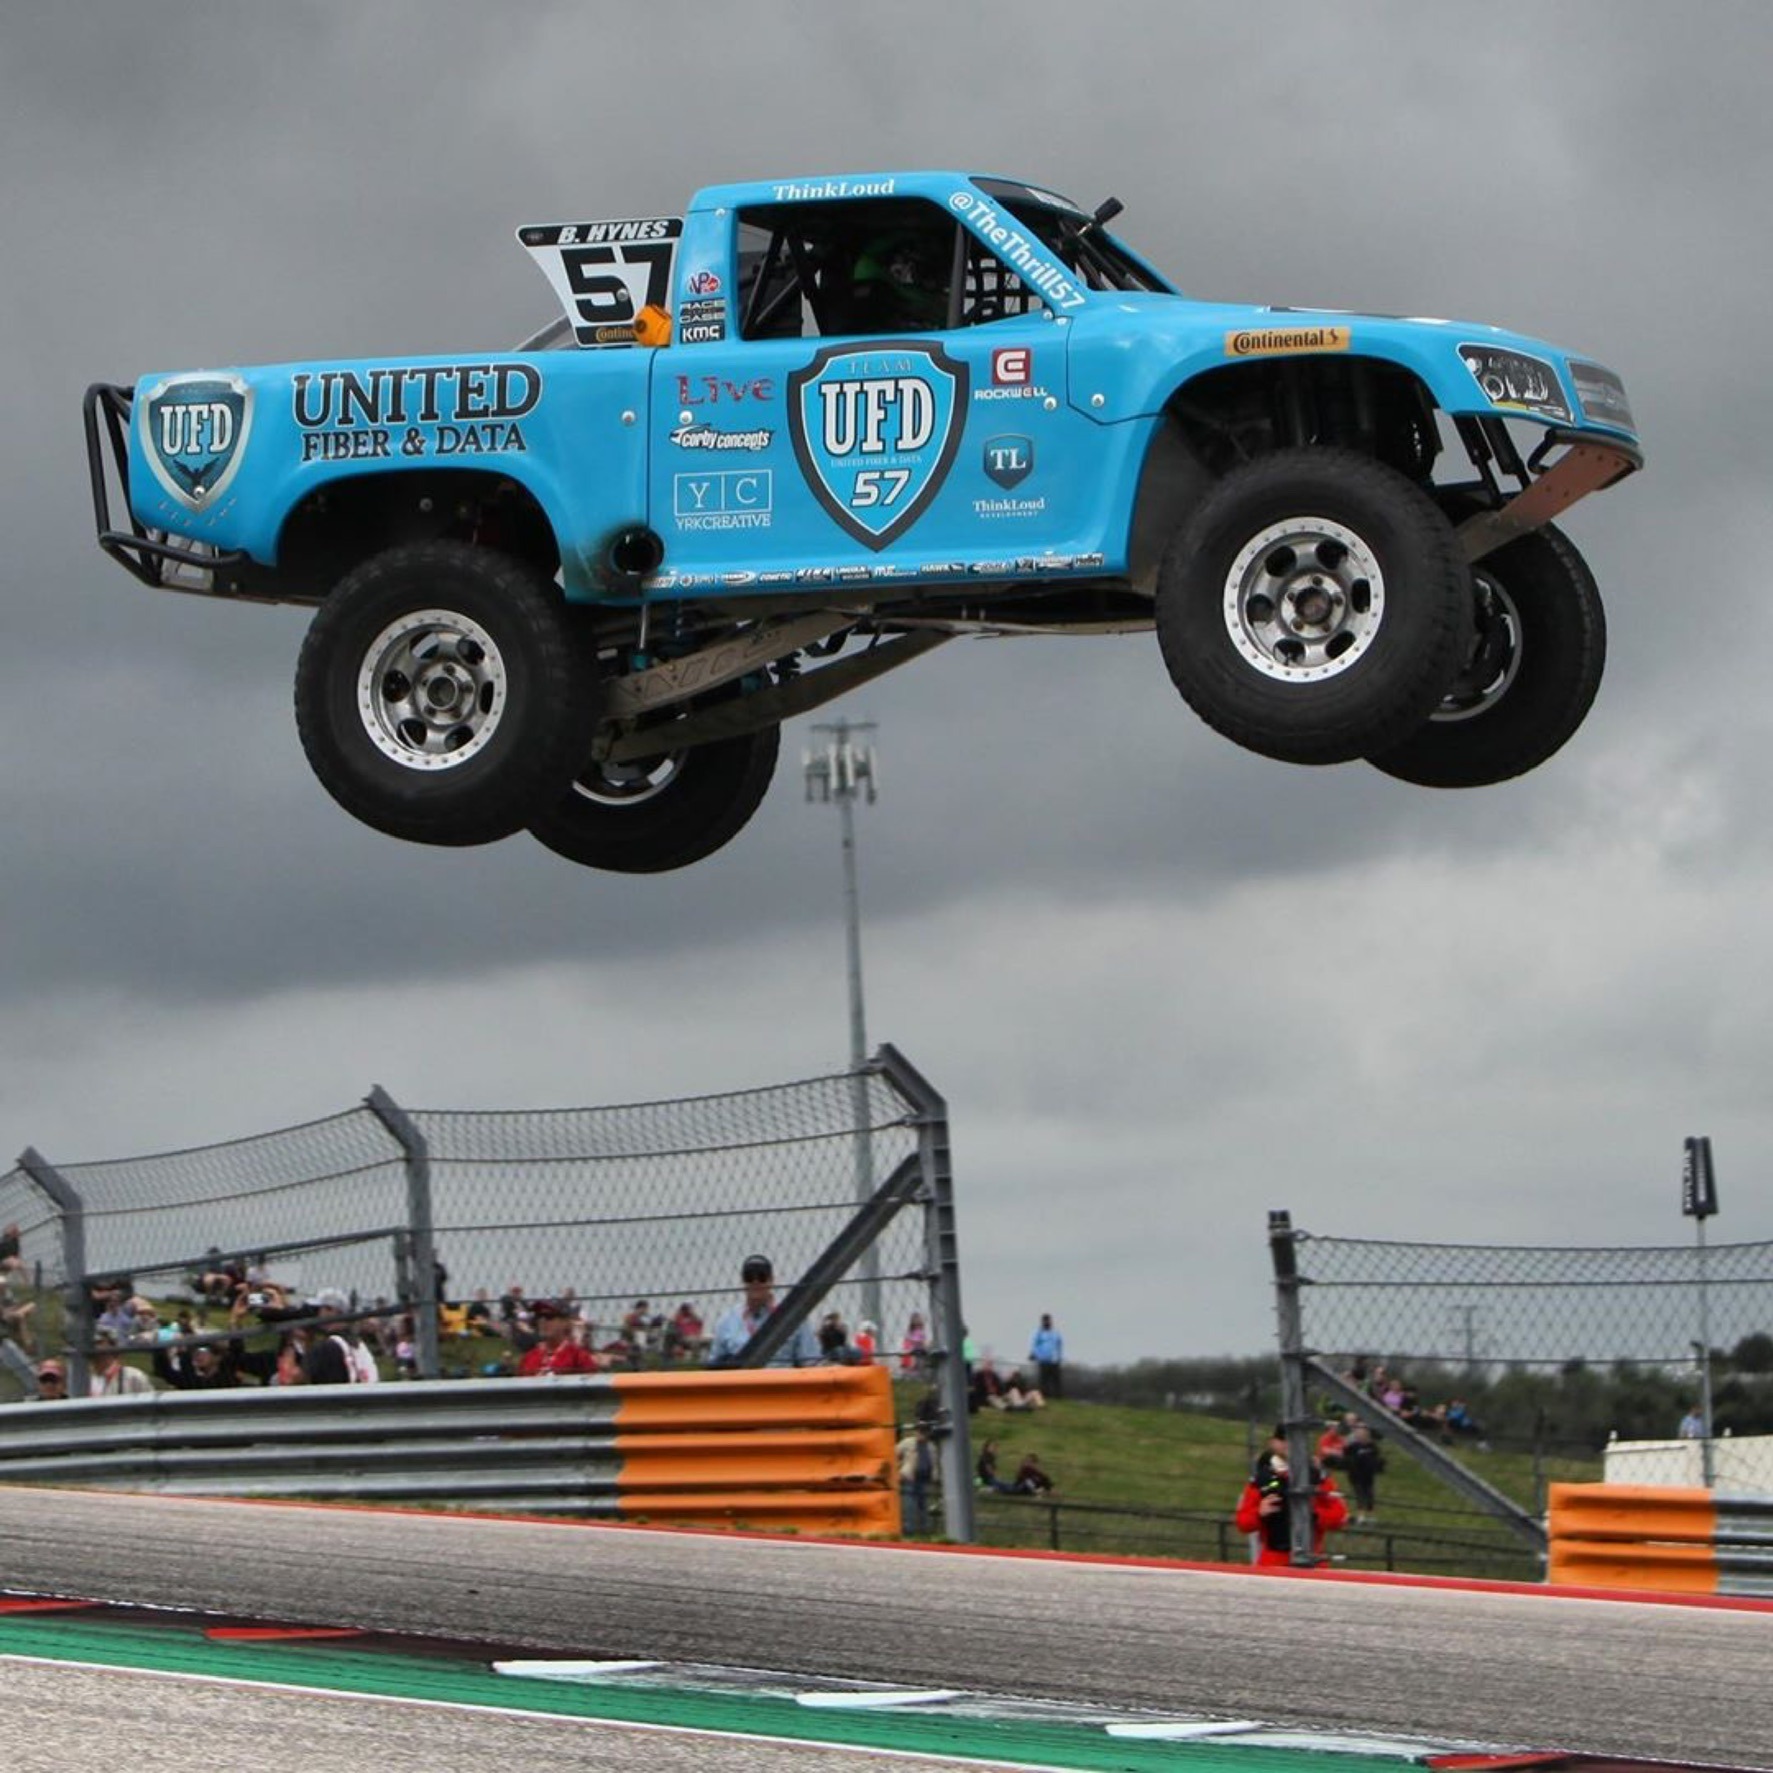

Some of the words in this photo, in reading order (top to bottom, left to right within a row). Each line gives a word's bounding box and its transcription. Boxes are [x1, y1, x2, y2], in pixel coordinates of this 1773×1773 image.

[772, 178, 895, 201] ThinkLoud
[558, 226, 580, 244] B.
[586, 220, 670, 242] HYNES
[949, 191, 1086, 310] @TheThrill57
[560, 243, 674, 323] 57
[1233, 329, 1325, 355] Continental
[292, 363, 543, 428] UNITED
[675, 373, 777, 407] Live
[974, 386, 1048, 401] ROCKWELL
[159, 402, 233, 456] UFD
[819, 376, 935, 458] UFD
[301, 428, 390, 462] FIBER
[402, 431, 427, 456] &
[436, 423, 526, 455] DATA
[717, 429, 771, 450] concepts
[990, 447, 1027, 471] TL
[688, 482, 710, 509] Y
[735, 477, 758, 505] C
[850, 468, 912, 508] 57
[972, 496, 1046, 512] ThinkLoud
[675, 513, 771, 531] YRKCREATIVE
